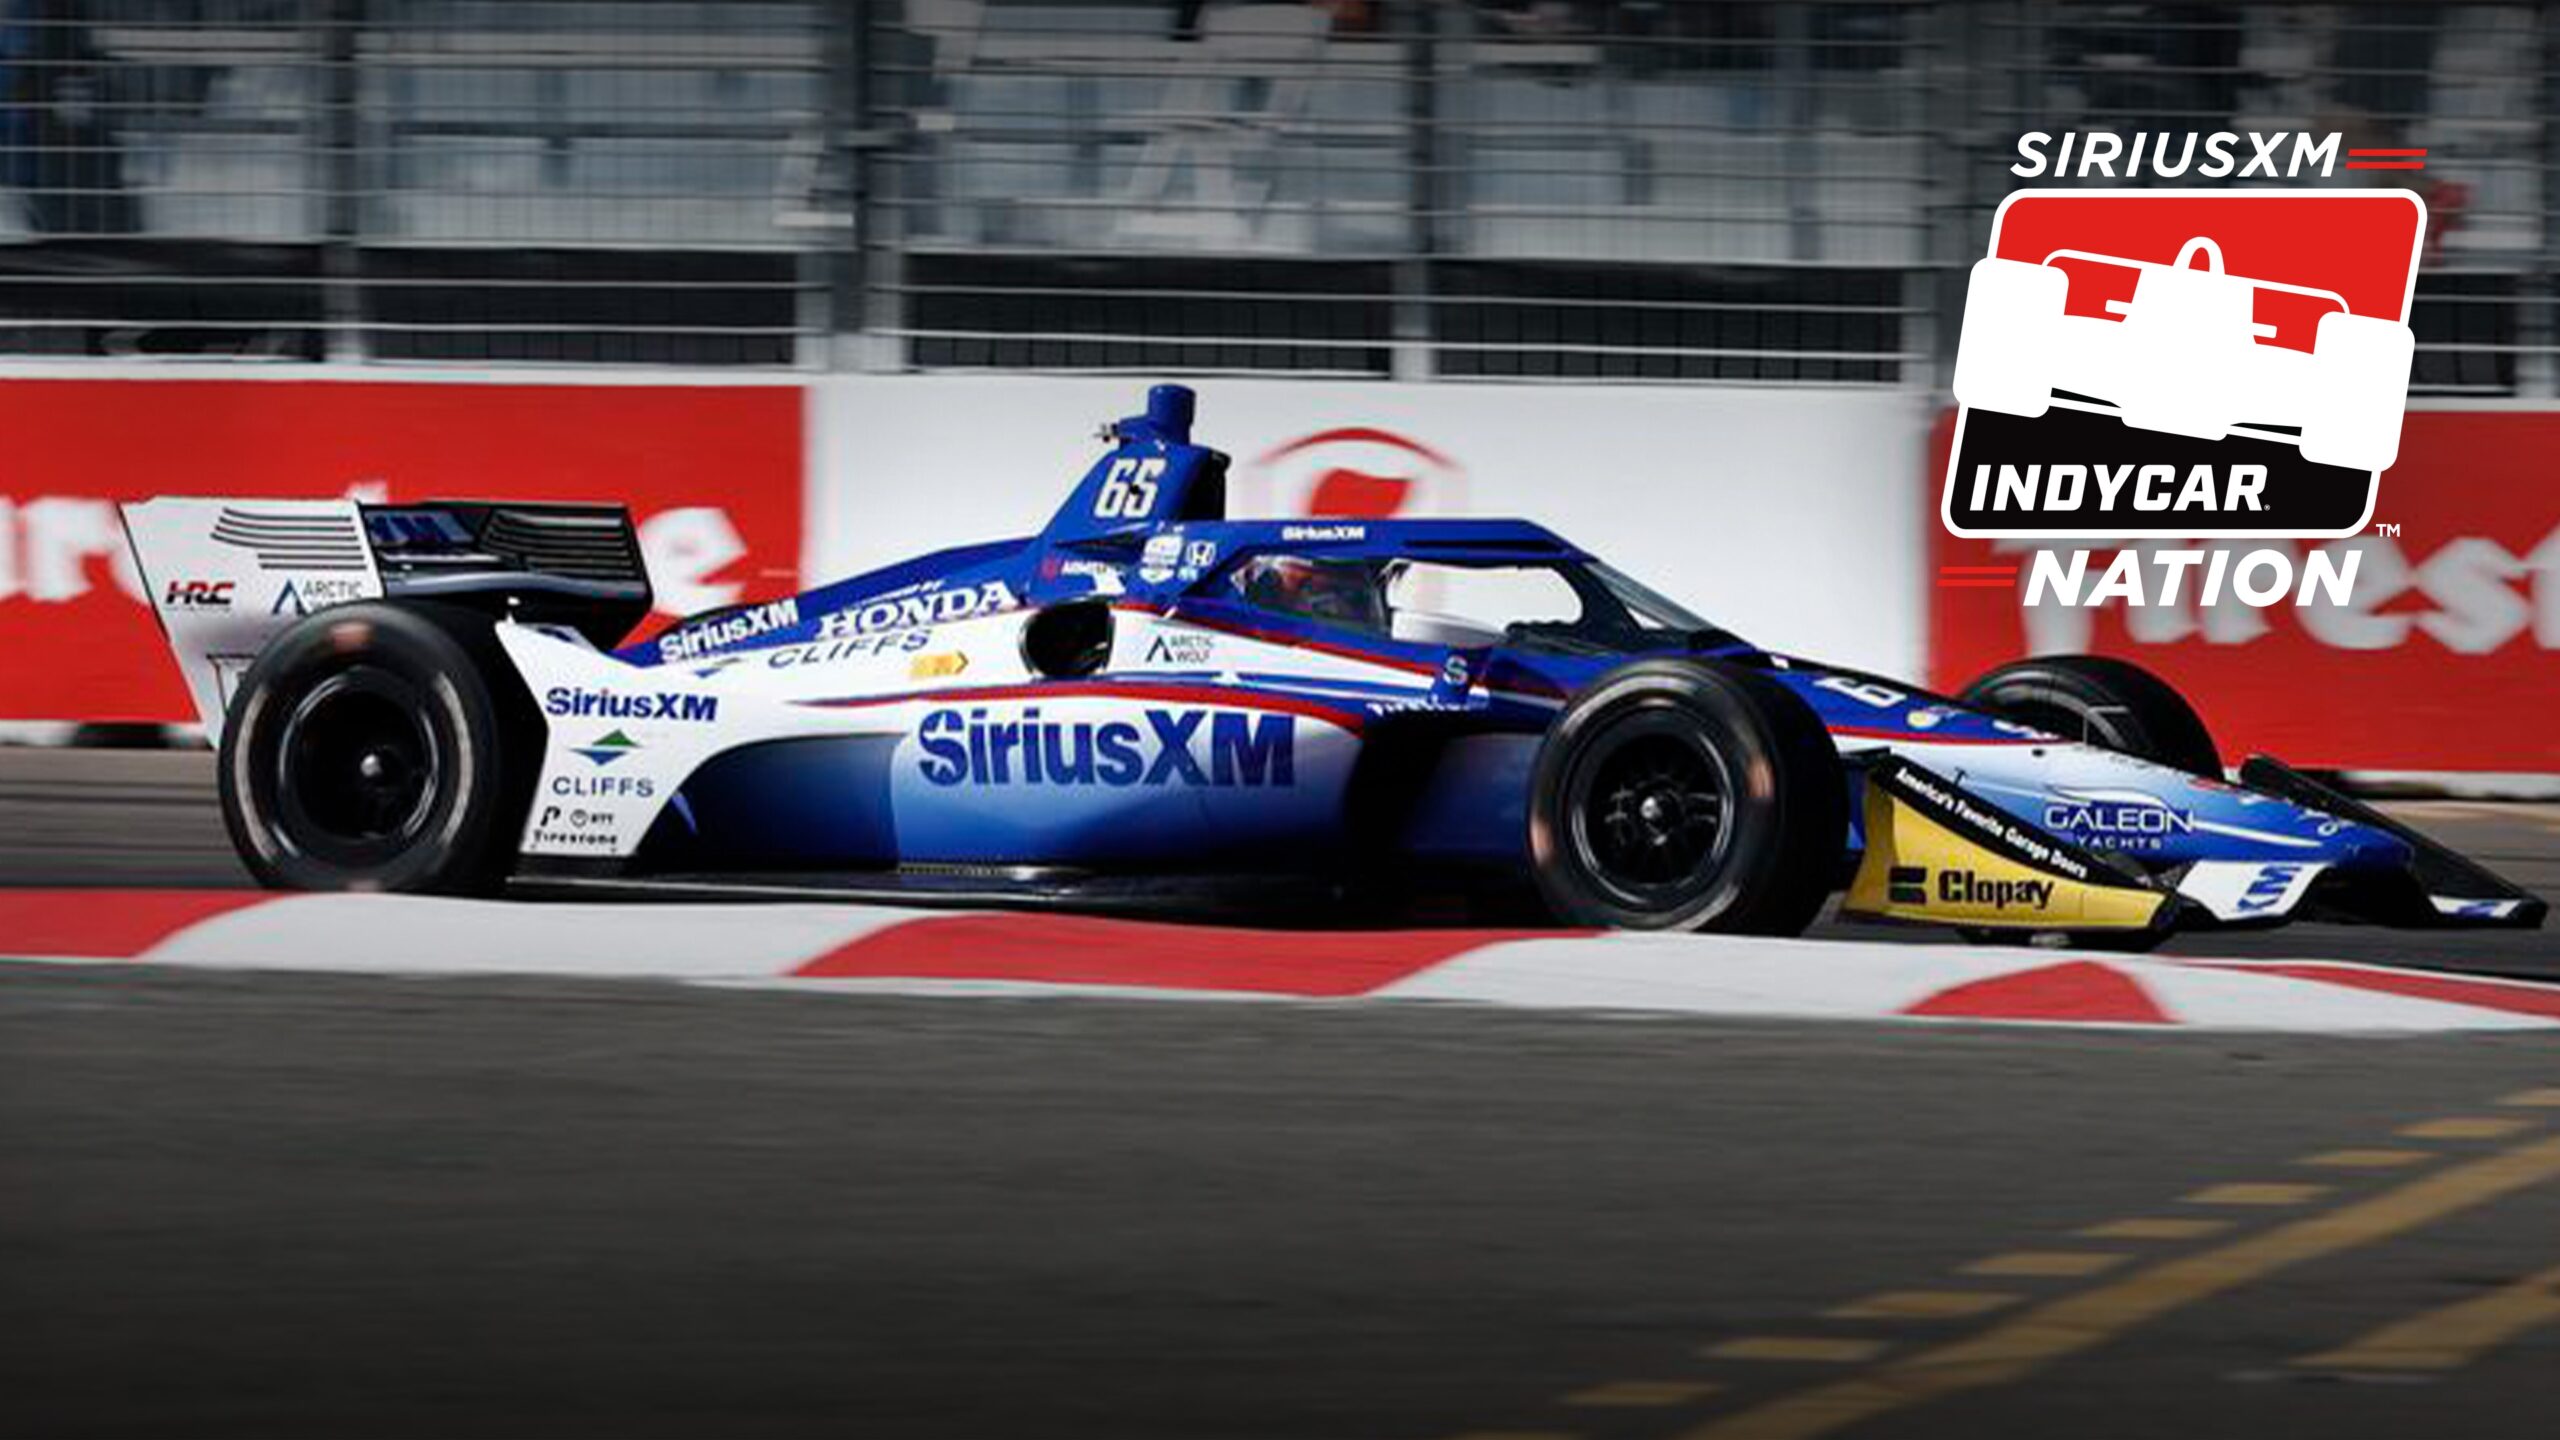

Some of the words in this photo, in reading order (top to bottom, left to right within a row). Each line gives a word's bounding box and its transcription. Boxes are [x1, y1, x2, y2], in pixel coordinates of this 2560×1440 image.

[165, 580, 235, 605] HRC
[303, 581, 362, 598] ARCTIC
[813, 580, 1019, 641] HONDA
[659, 597, 798, 663] SiriusXM
[767, 628, 932, 668] CLIFFS
[545, 687, 718, 722] SiriusXM
[918, 707, 1295, 787] SiriusXM
[552, 776, 654, 798] CLIFFS
[1895, 767, 1955, 812] America's
[1955, 799, 2004, 838] Favorite
[2005, 825, 2051, 861] Garage
[2050, 848, 2089, 880] Doors
[2044, 804, 2195, 834] GALEON
[2076, 834, 2162, 850] YACHTS
[1938, 870, 2053, 910] Clopay
